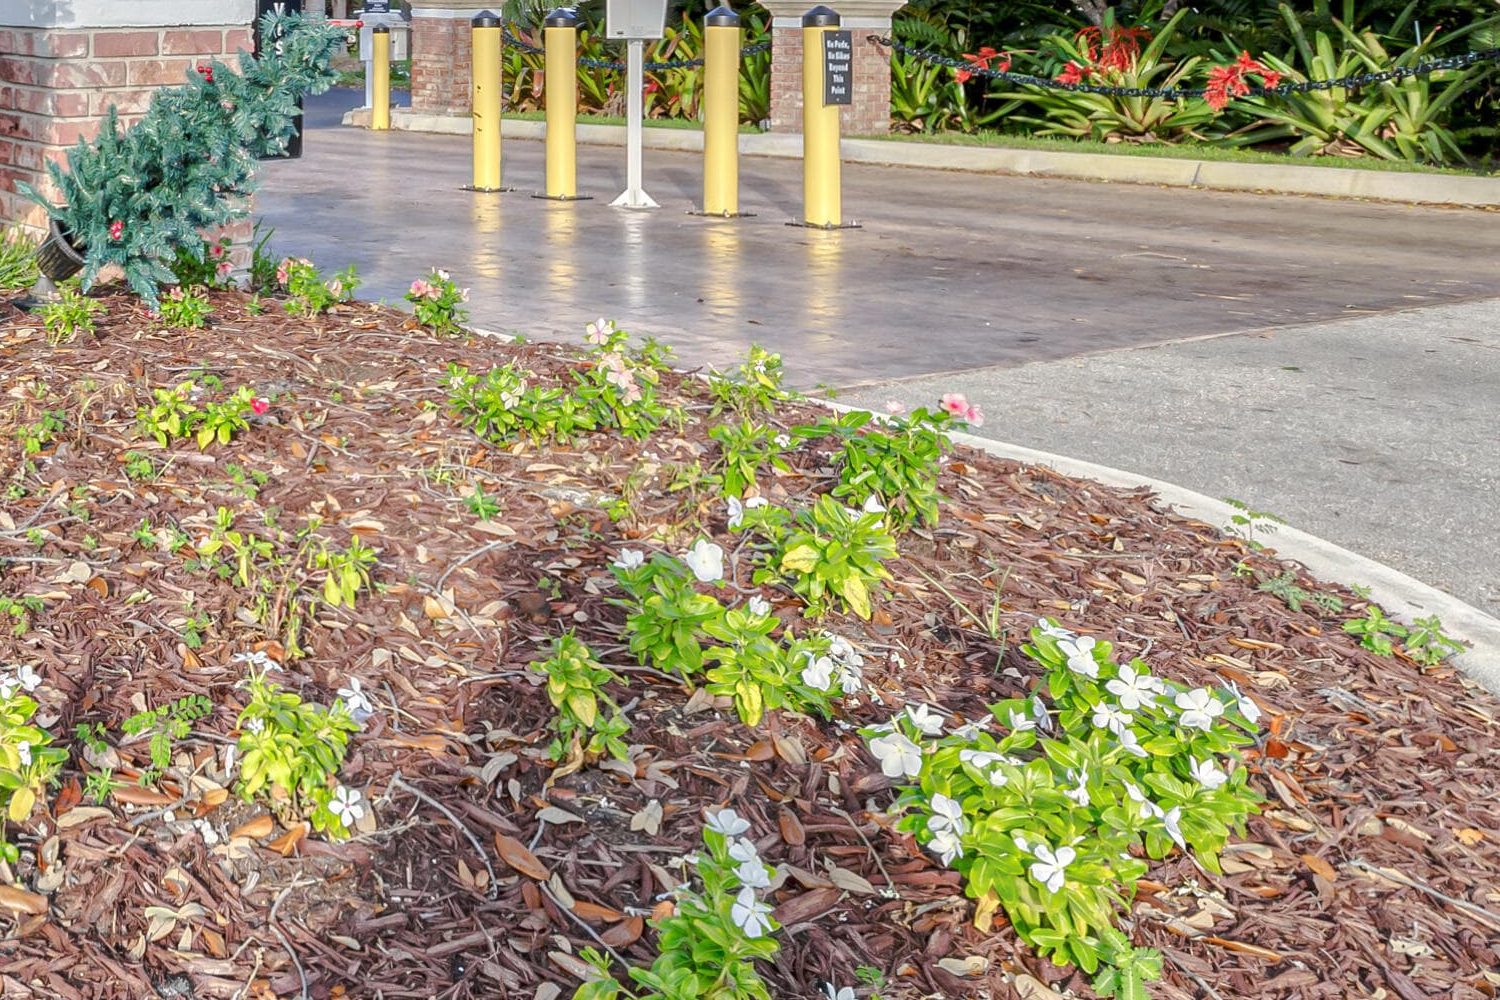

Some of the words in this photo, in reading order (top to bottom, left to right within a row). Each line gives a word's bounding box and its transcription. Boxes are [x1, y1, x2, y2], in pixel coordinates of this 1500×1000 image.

[829, 62, 848, 73] Beyond
[833, 74, 844, 83] This
[831, 86, 845, 95] Point
